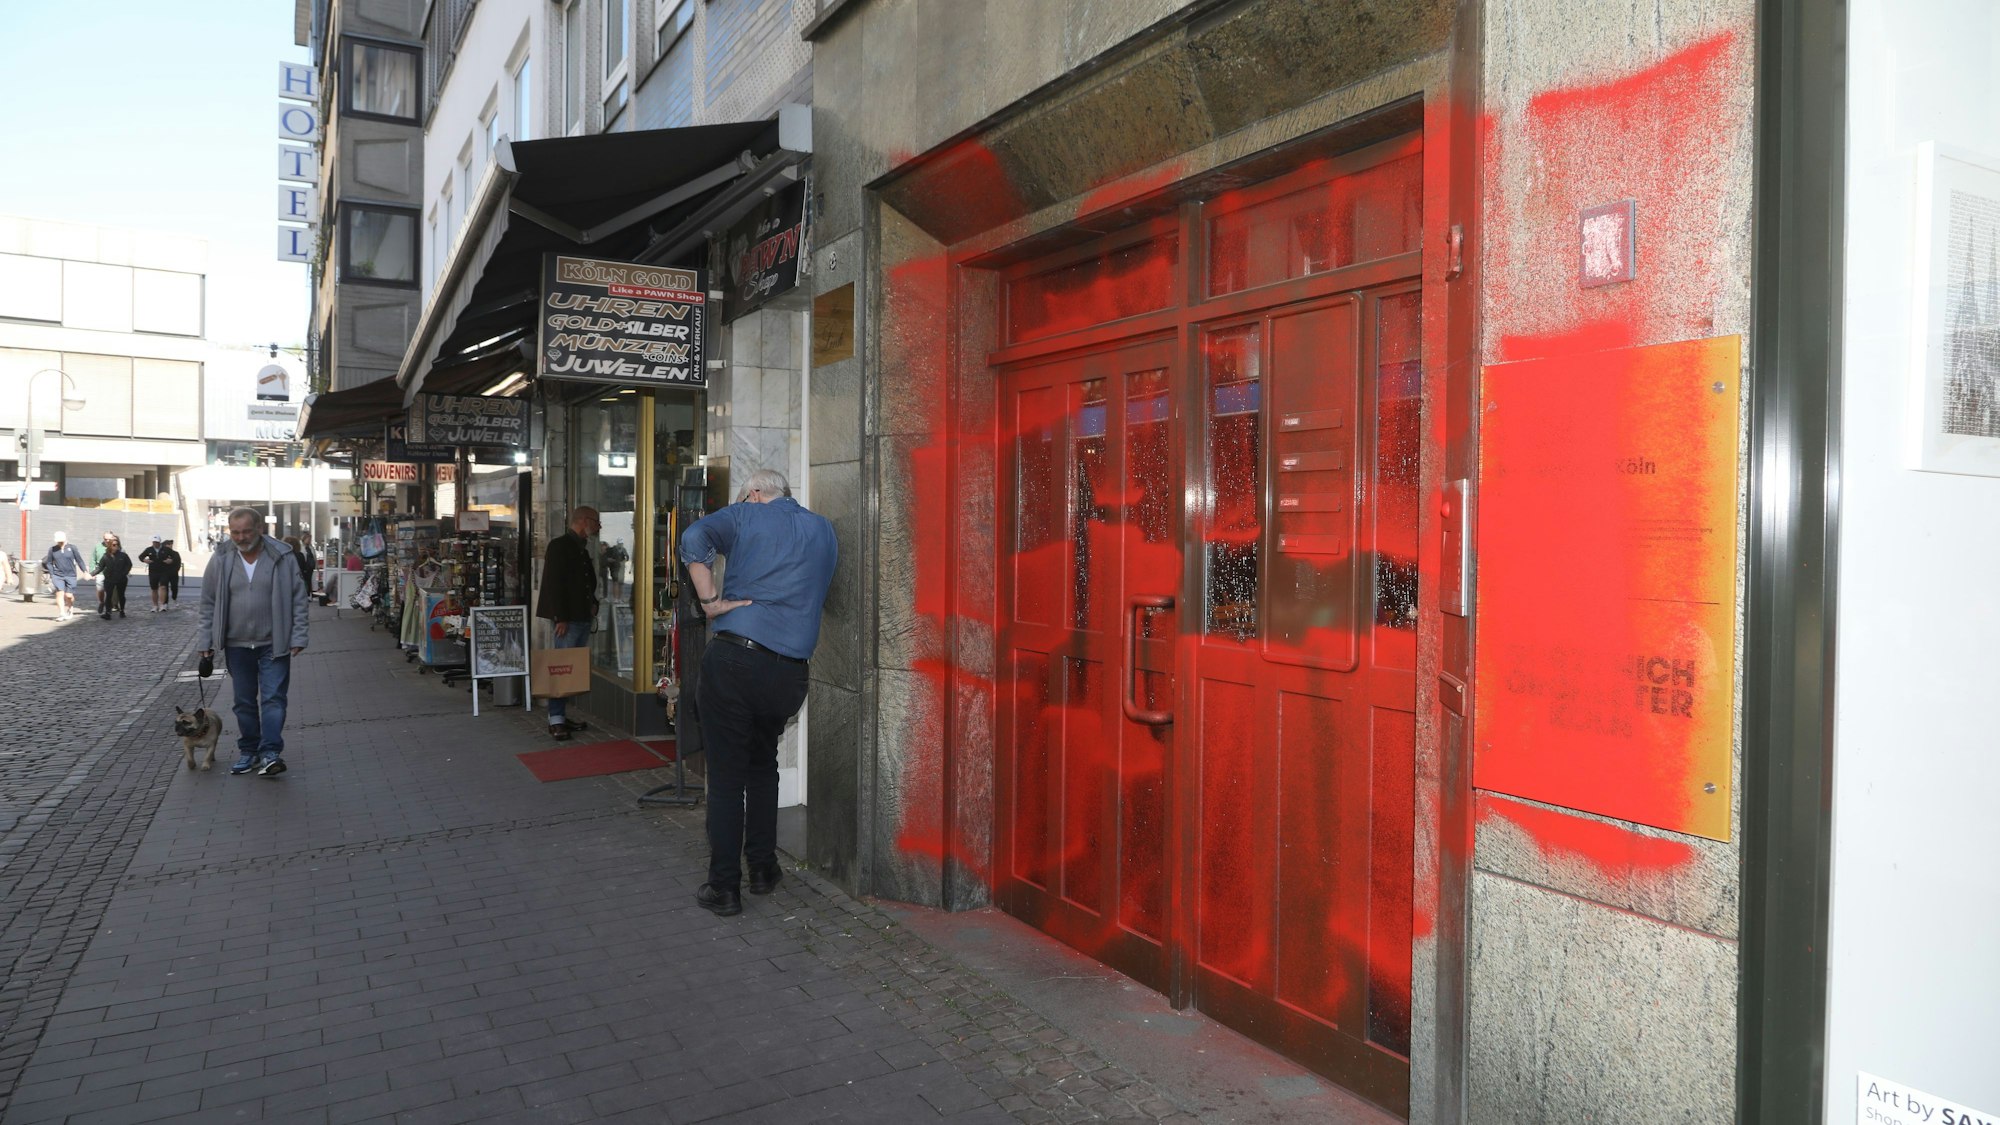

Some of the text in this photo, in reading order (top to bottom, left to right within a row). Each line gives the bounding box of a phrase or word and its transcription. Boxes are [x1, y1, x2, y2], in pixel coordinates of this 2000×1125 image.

[282, 66, 316, 260] HOTEL
[564, 261, 692, 291] KÖLN GOLD
[743, 271, 779, 301] Shop
[547, 292, 691, 321] UHREN
[612, 286, 634, 295] Like
[644, 290, 675, 299] PAWN
[677, 293, 703, 303] Shop
[694, 307, 703, 352] VERKAUF
[548, 332, 691, 357] MÜNZEN
[550, 354, 690, 381] JUWELEN
[648, 353, 685, 365] COINS
[428, 395, 521, 416] UHREN
[448, 426, 522, 444] JUWELEN
[364, 464, 417, 481] SOUVENIRS
[1867, 1082, 1900, 1108] Art
[1907, 1093, 1935, 1122] by
